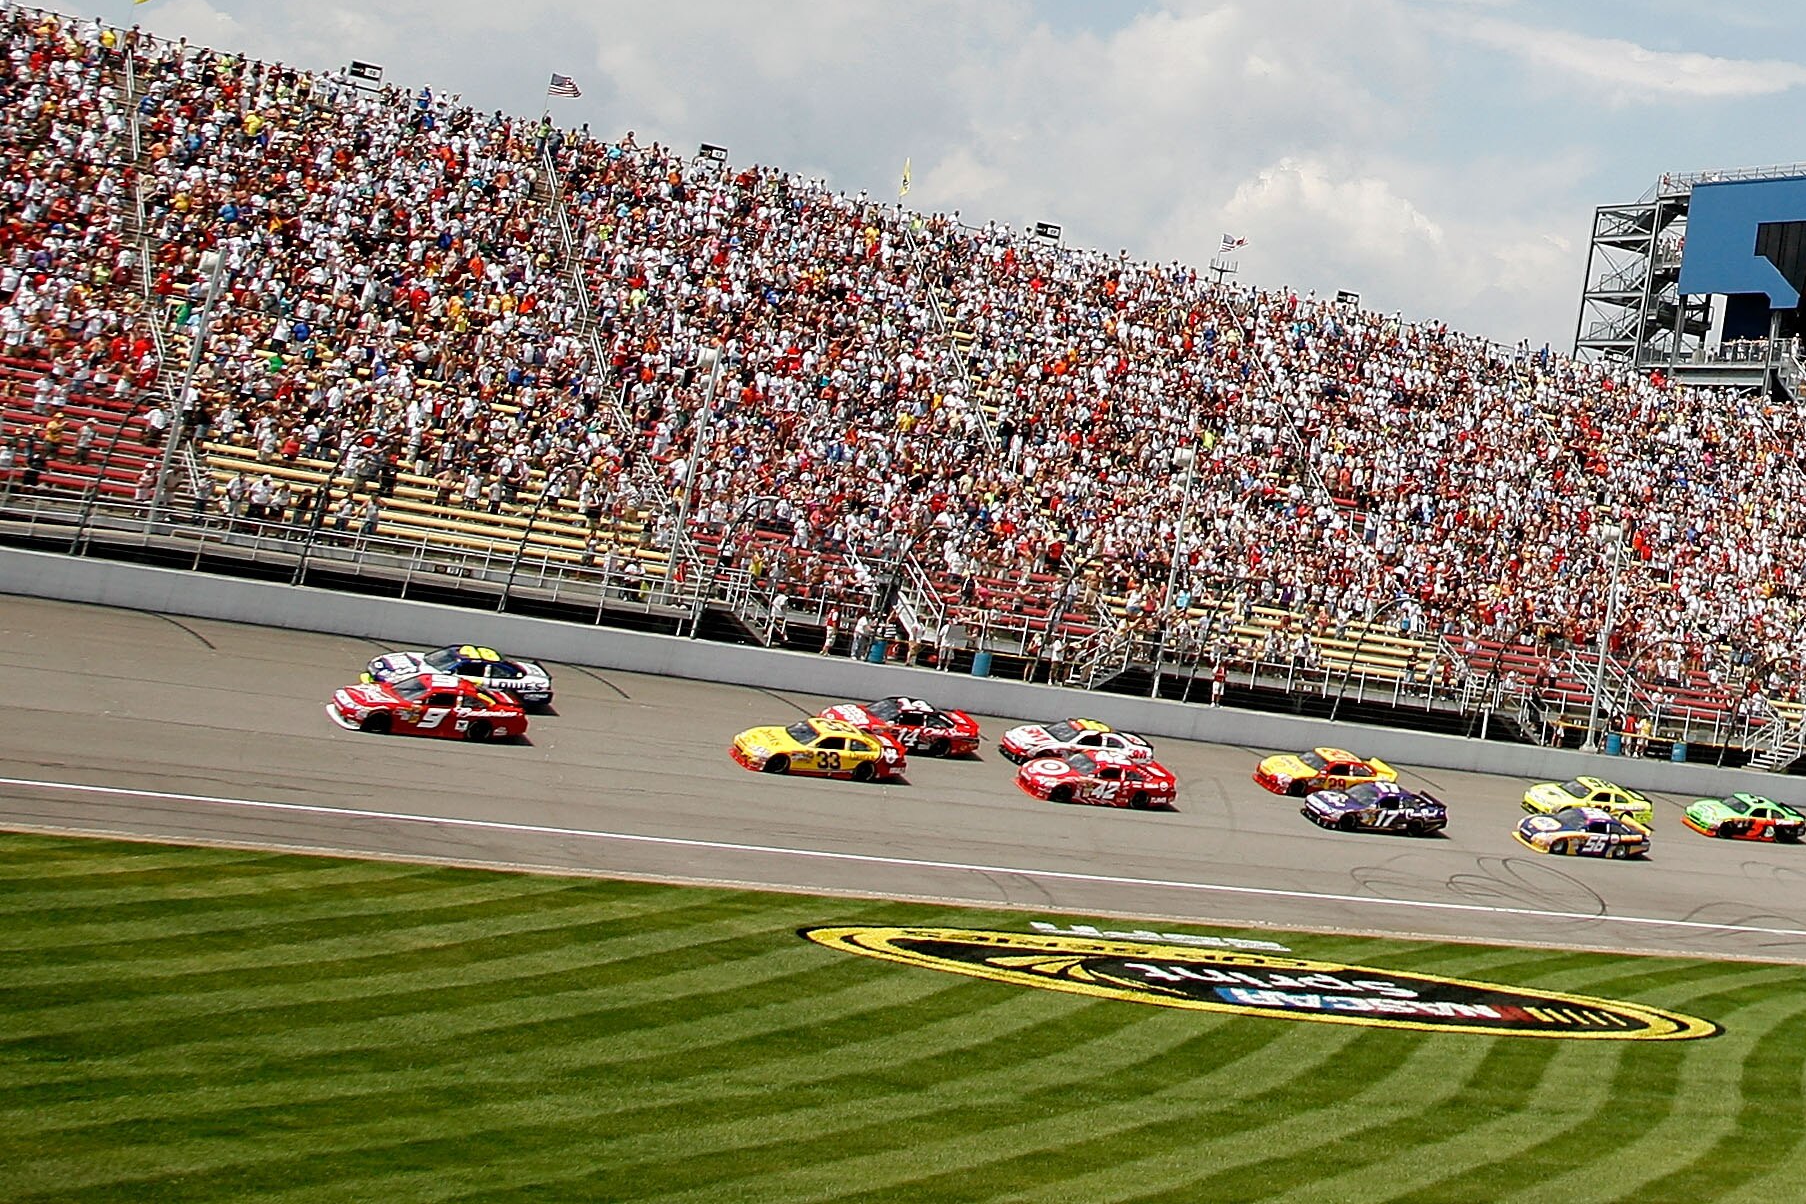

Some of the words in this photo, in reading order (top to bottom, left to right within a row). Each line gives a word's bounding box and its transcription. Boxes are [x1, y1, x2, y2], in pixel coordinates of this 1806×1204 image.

[417, 708, 451, 727] 9
[453, 707, 523, 718] Budweiser
[897, 728, 921, 746] 14
[816, 750, 842, 770] 33
[1091, 781, 1121, 799] 42
[1328, 777, 1347, 790] 29
[1375, 810, 1399, 827] 17
[1582, 836, 1608, 853] 56
[1124, 962, 1419, 999] Sprint
[1230, 988, 1502, 1019] NASCAR
